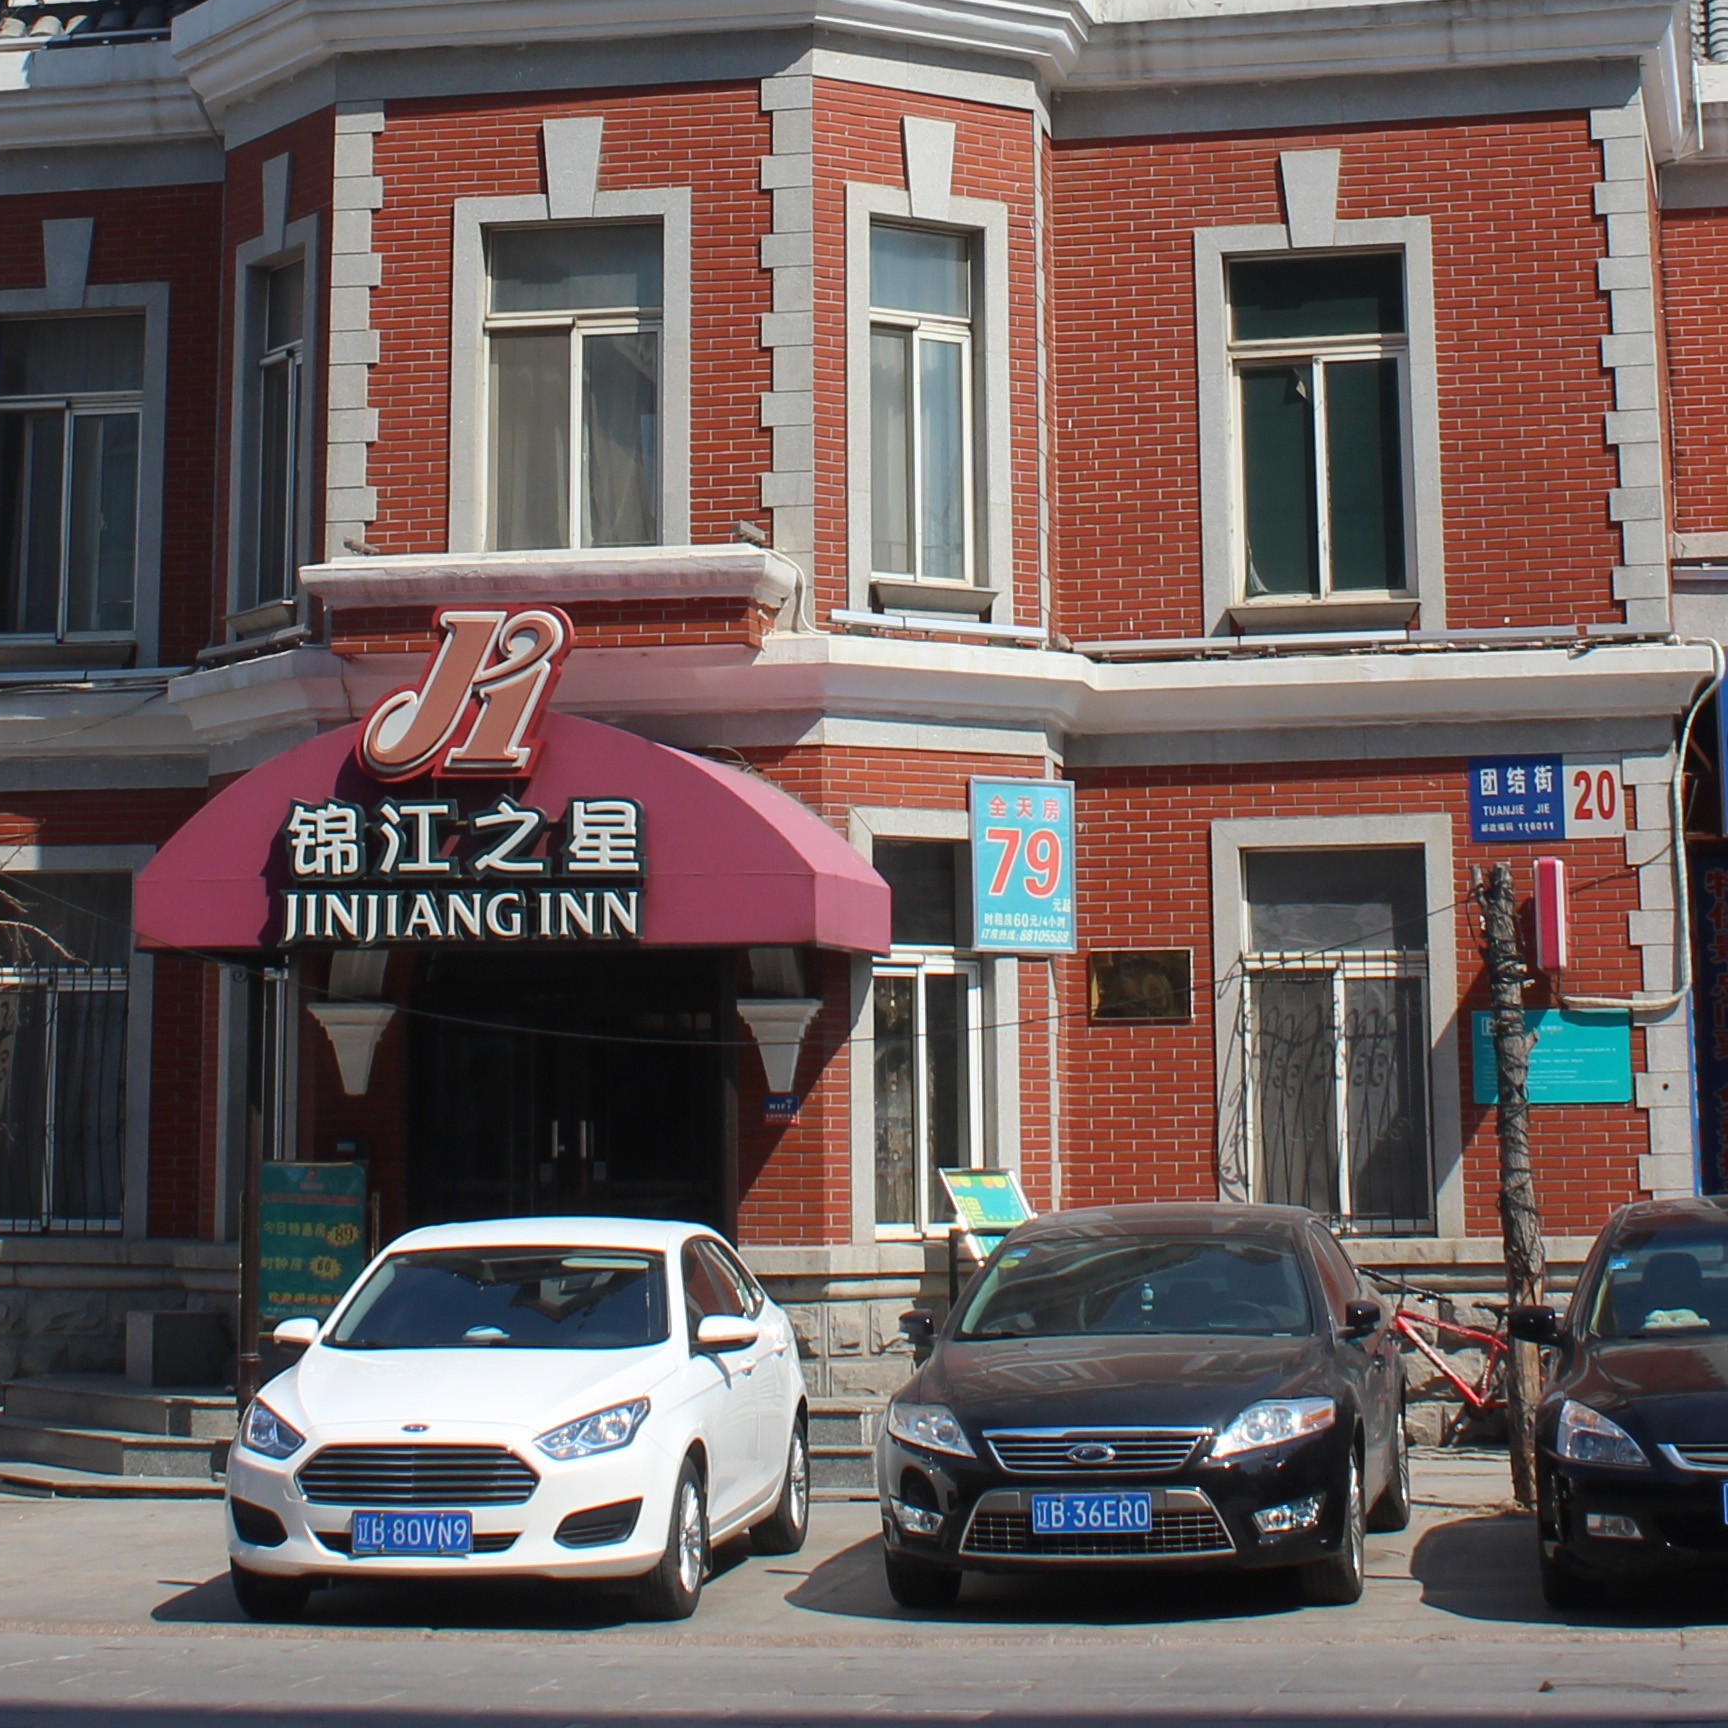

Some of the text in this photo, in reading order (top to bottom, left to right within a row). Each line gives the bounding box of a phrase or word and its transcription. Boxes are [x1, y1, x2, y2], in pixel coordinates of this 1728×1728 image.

[1480, 765, 1553, 797] 团结街
[1573, 769, 1616, 821] 20
[988, 795, 1060, 822] 全天房
[1482, 803, 1551, 817] TUANJIE JIE
[285, 800, 642, 877] 锦江之星
[985, 827, 1063, 899] 79
[281, 889, 641, 944] JINJIANG INN
[335, 1227, 354, 1242] 89
